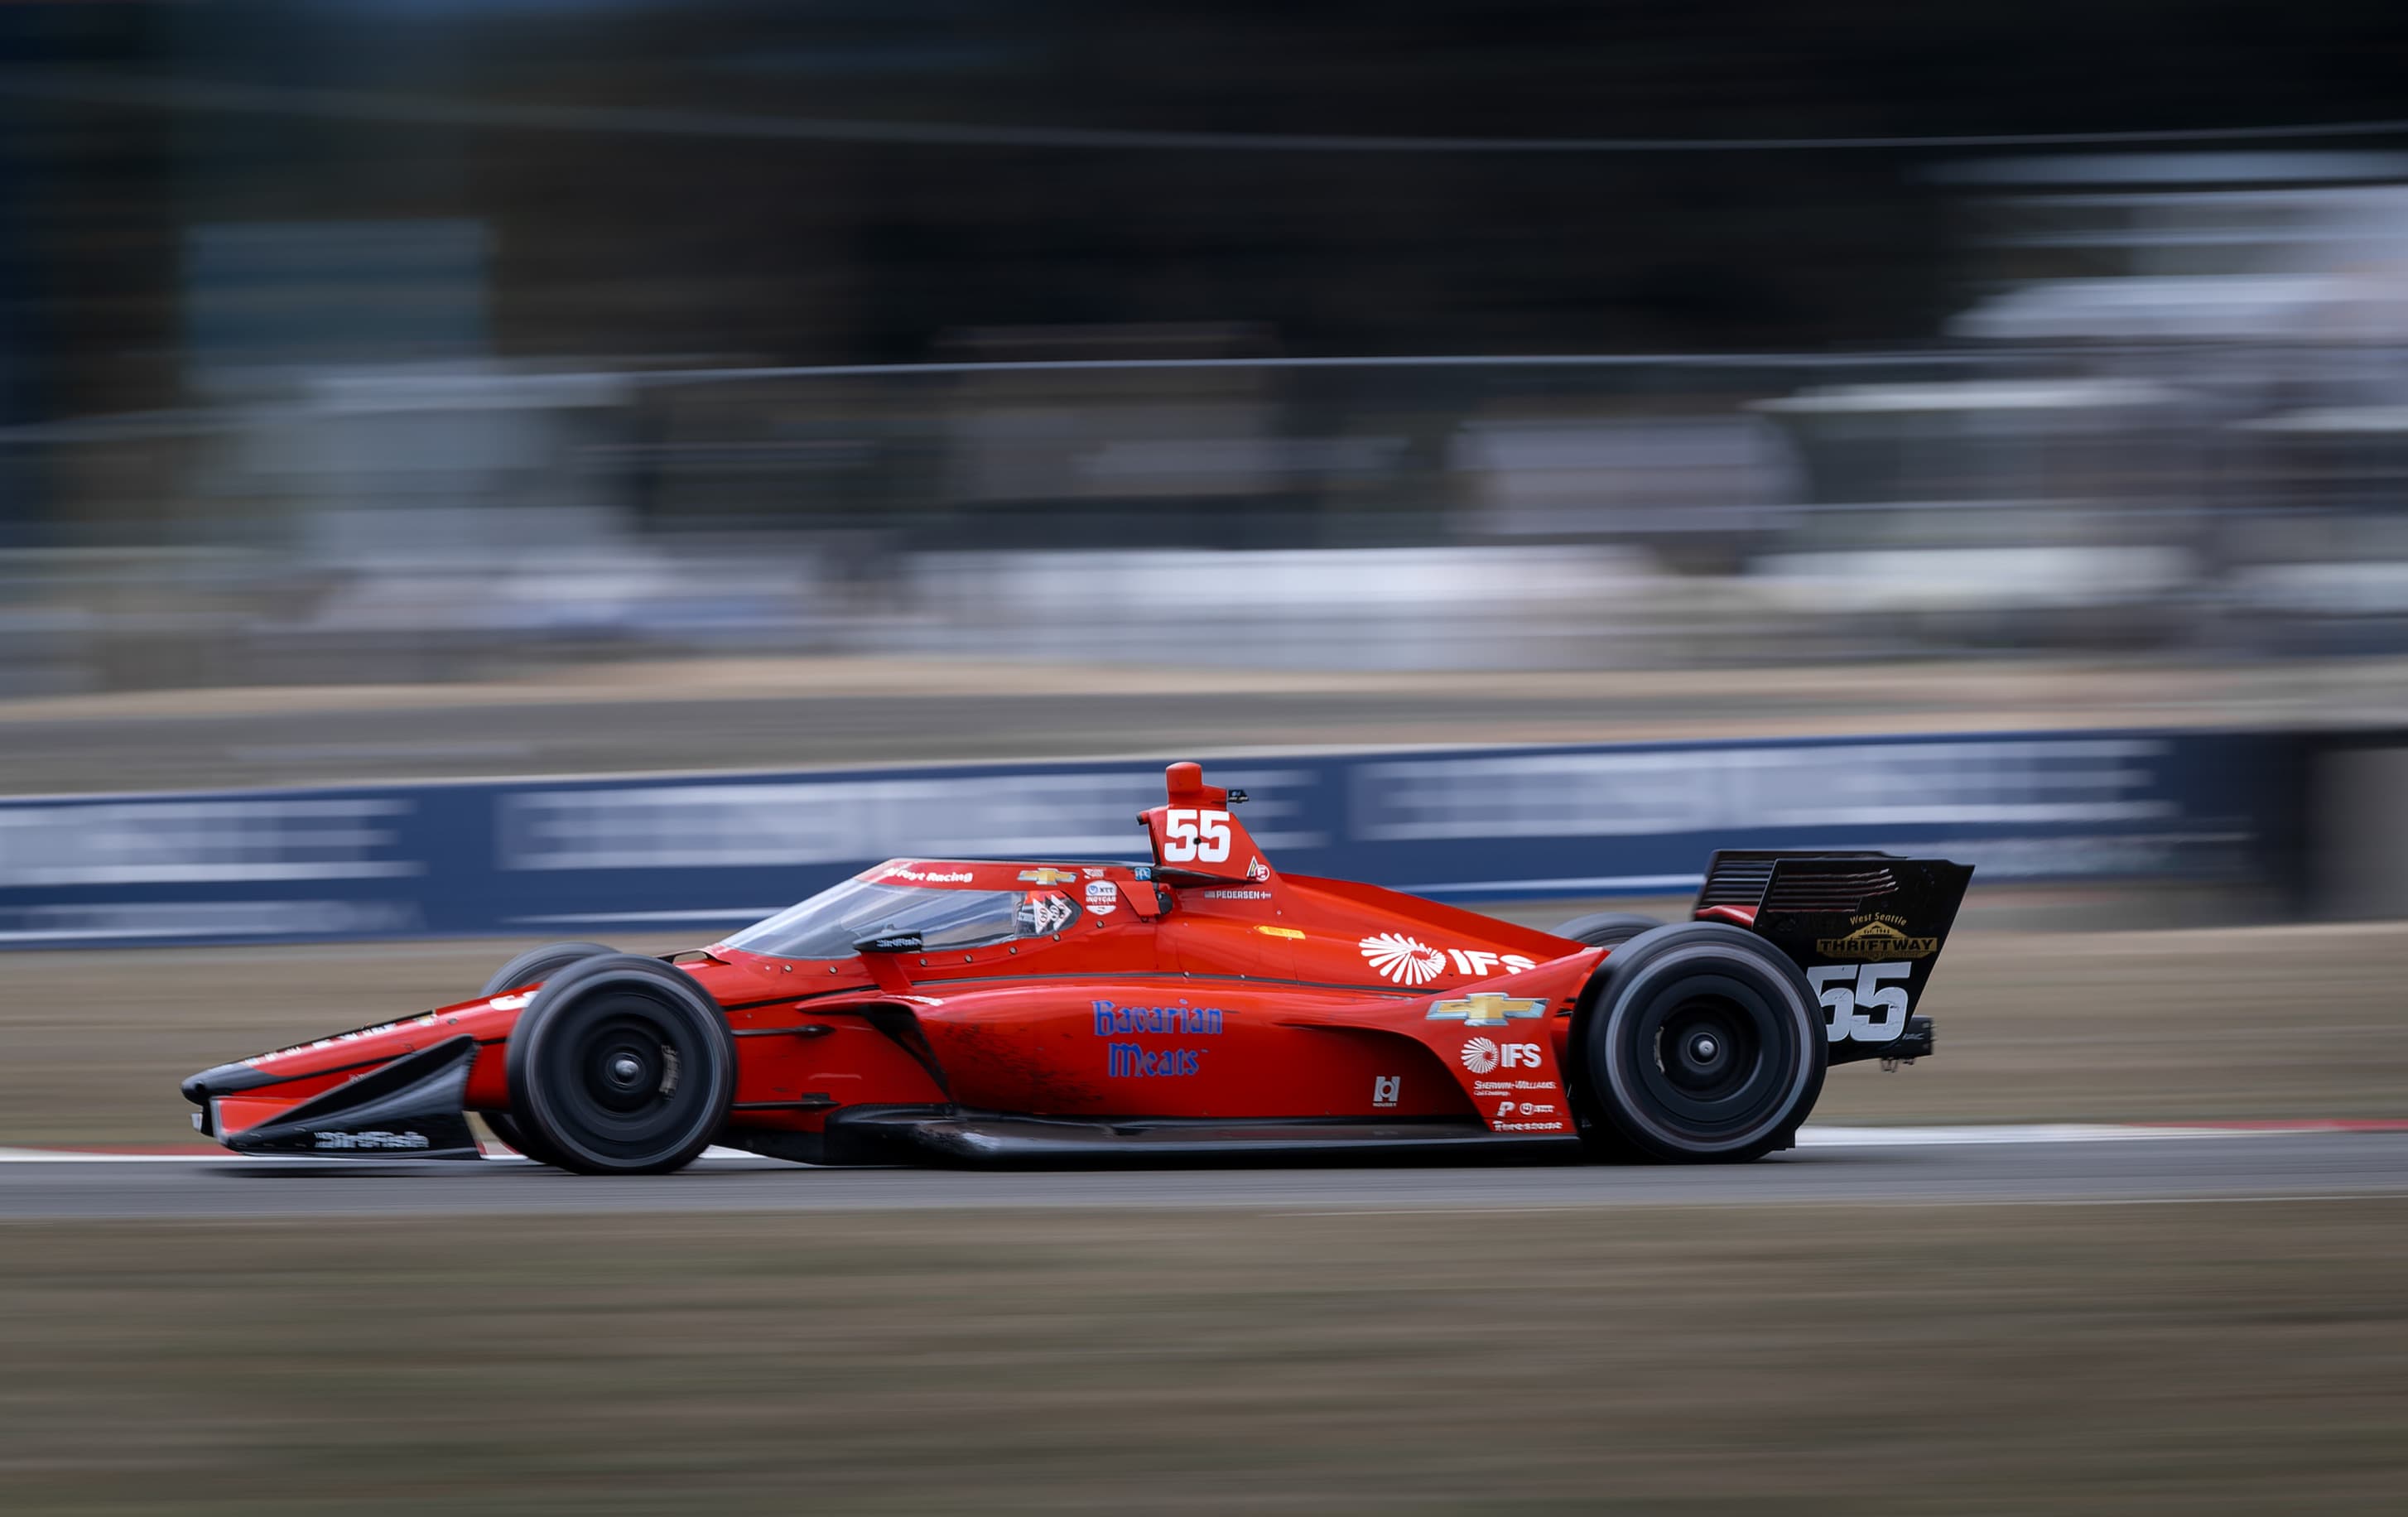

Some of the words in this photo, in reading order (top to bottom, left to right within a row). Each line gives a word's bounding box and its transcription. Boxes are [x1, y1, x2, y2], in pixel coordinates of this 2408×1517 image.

[1163, 809, 1230, 863] 55
[926, 871, 973, 883] Racing
[1216, 890, 1259, 899] PEDERSEN
[1849, 913, 1871, 926] West
[1875, 912, 1908, 927] Seattle
[1821, 938, 1934, 951] THRIFTWAY
[1447, 949, 1537, 975] IFS
[1806, 961, 1912, 1043] 55
[1091, 999, 1223, 1036] Bavarian
[1500, 1043, 1542, 1068] IFS
